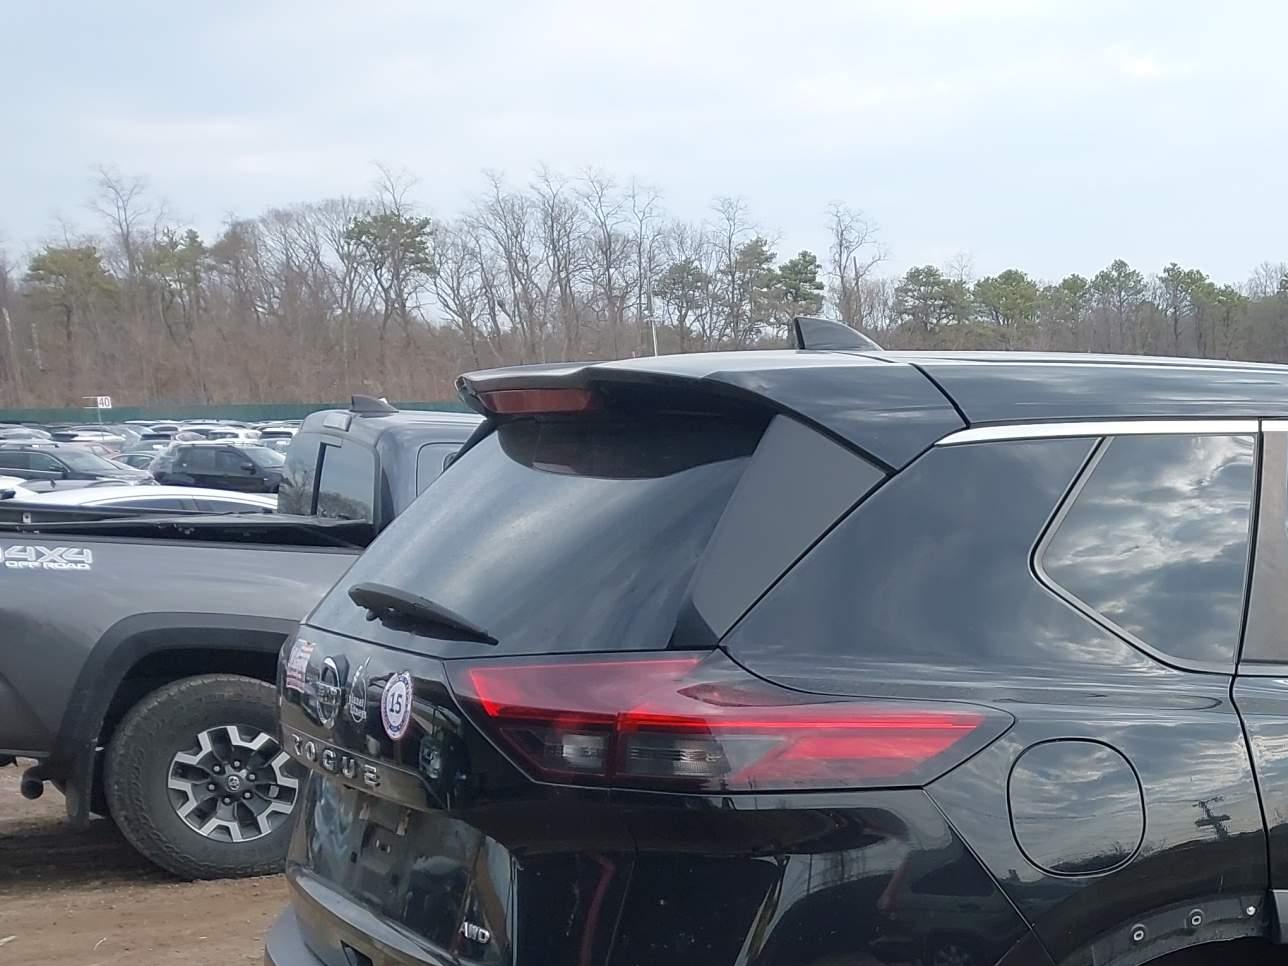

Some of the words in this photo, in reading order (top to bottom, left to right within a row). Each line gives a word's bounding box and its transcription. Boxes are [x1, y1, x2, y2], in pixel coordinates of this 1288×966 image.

[389, 691, 402, 714] 15
[291, 733, 377, 786] ROGUE
[459, 921, 490, 944] AWD
